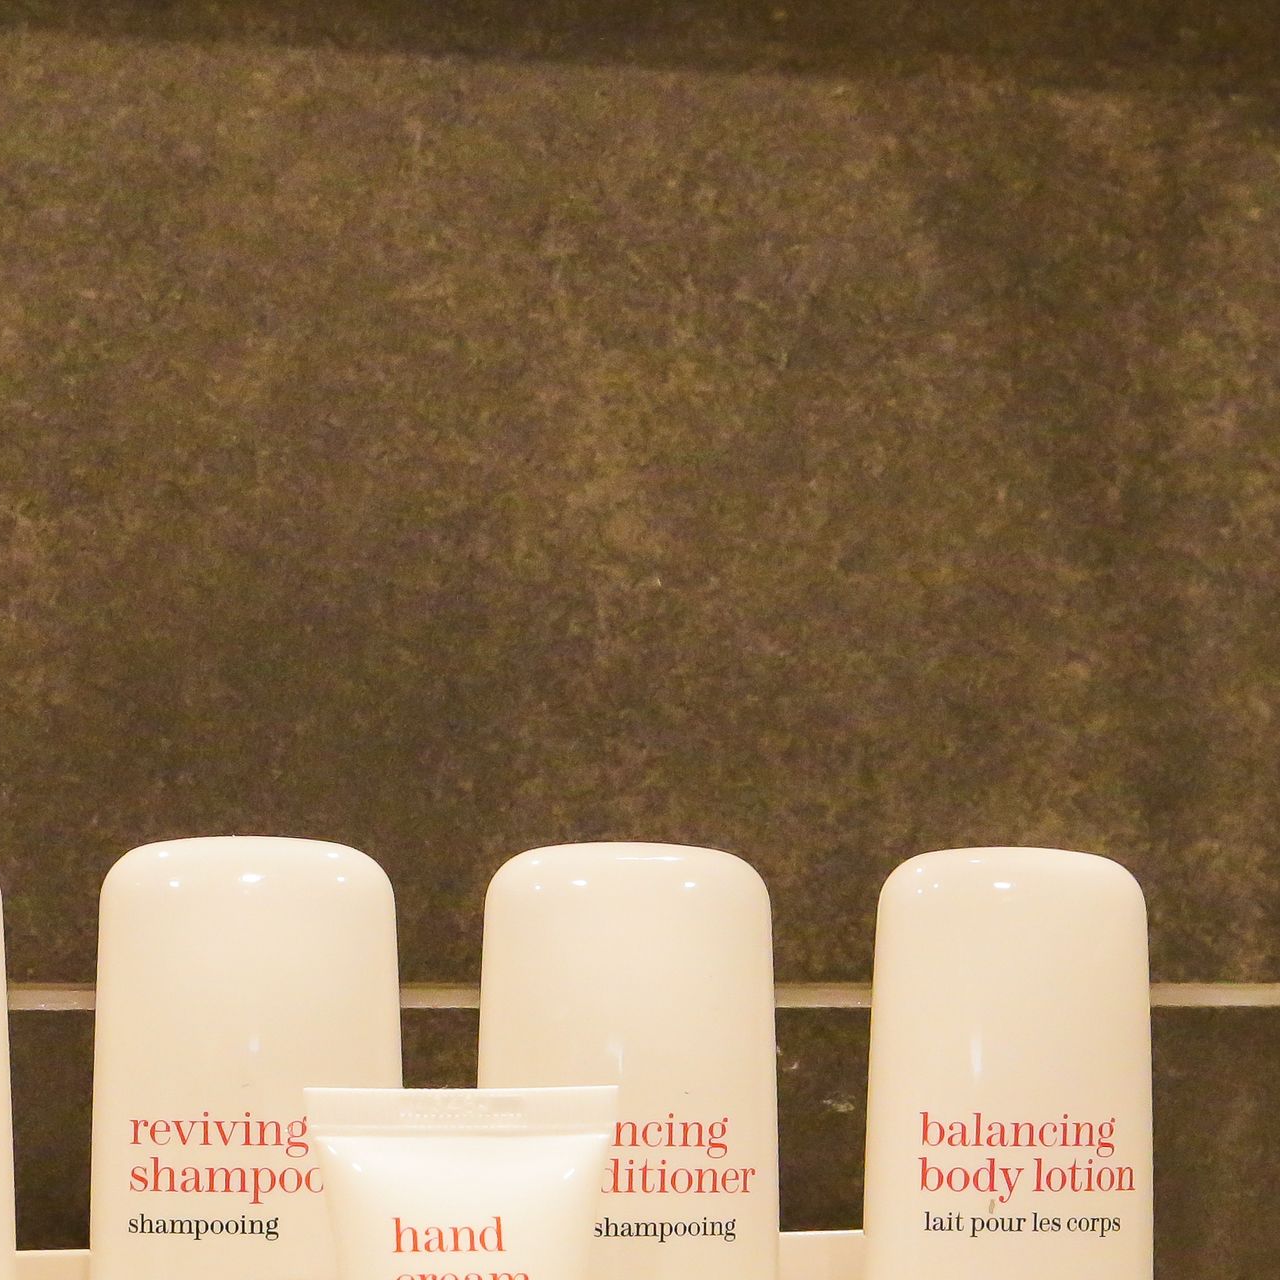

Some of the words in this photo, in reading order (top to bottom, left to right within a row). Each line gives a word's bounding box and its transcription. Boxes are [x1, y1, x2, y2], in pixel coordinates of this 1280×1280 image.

[129, 1111, 310, 1158] reviving
[919, 1111, 1116, 1158] balancing
[917, 1156, 1025, 1204] body
[1032, 1158, 1136, 1193] lotion
[128, 1213, 280, 1242] shampooing
[392, 1216, 506, 1253] hand
[593, 1216, 737, 1244] shampooing
[924, 1211, 965, 1232] lait
[969, 1210, 1027, 1238] pour
[1031, 1211, 1062, 1233] les
[1066, 1216, 1121, 1238] corps
